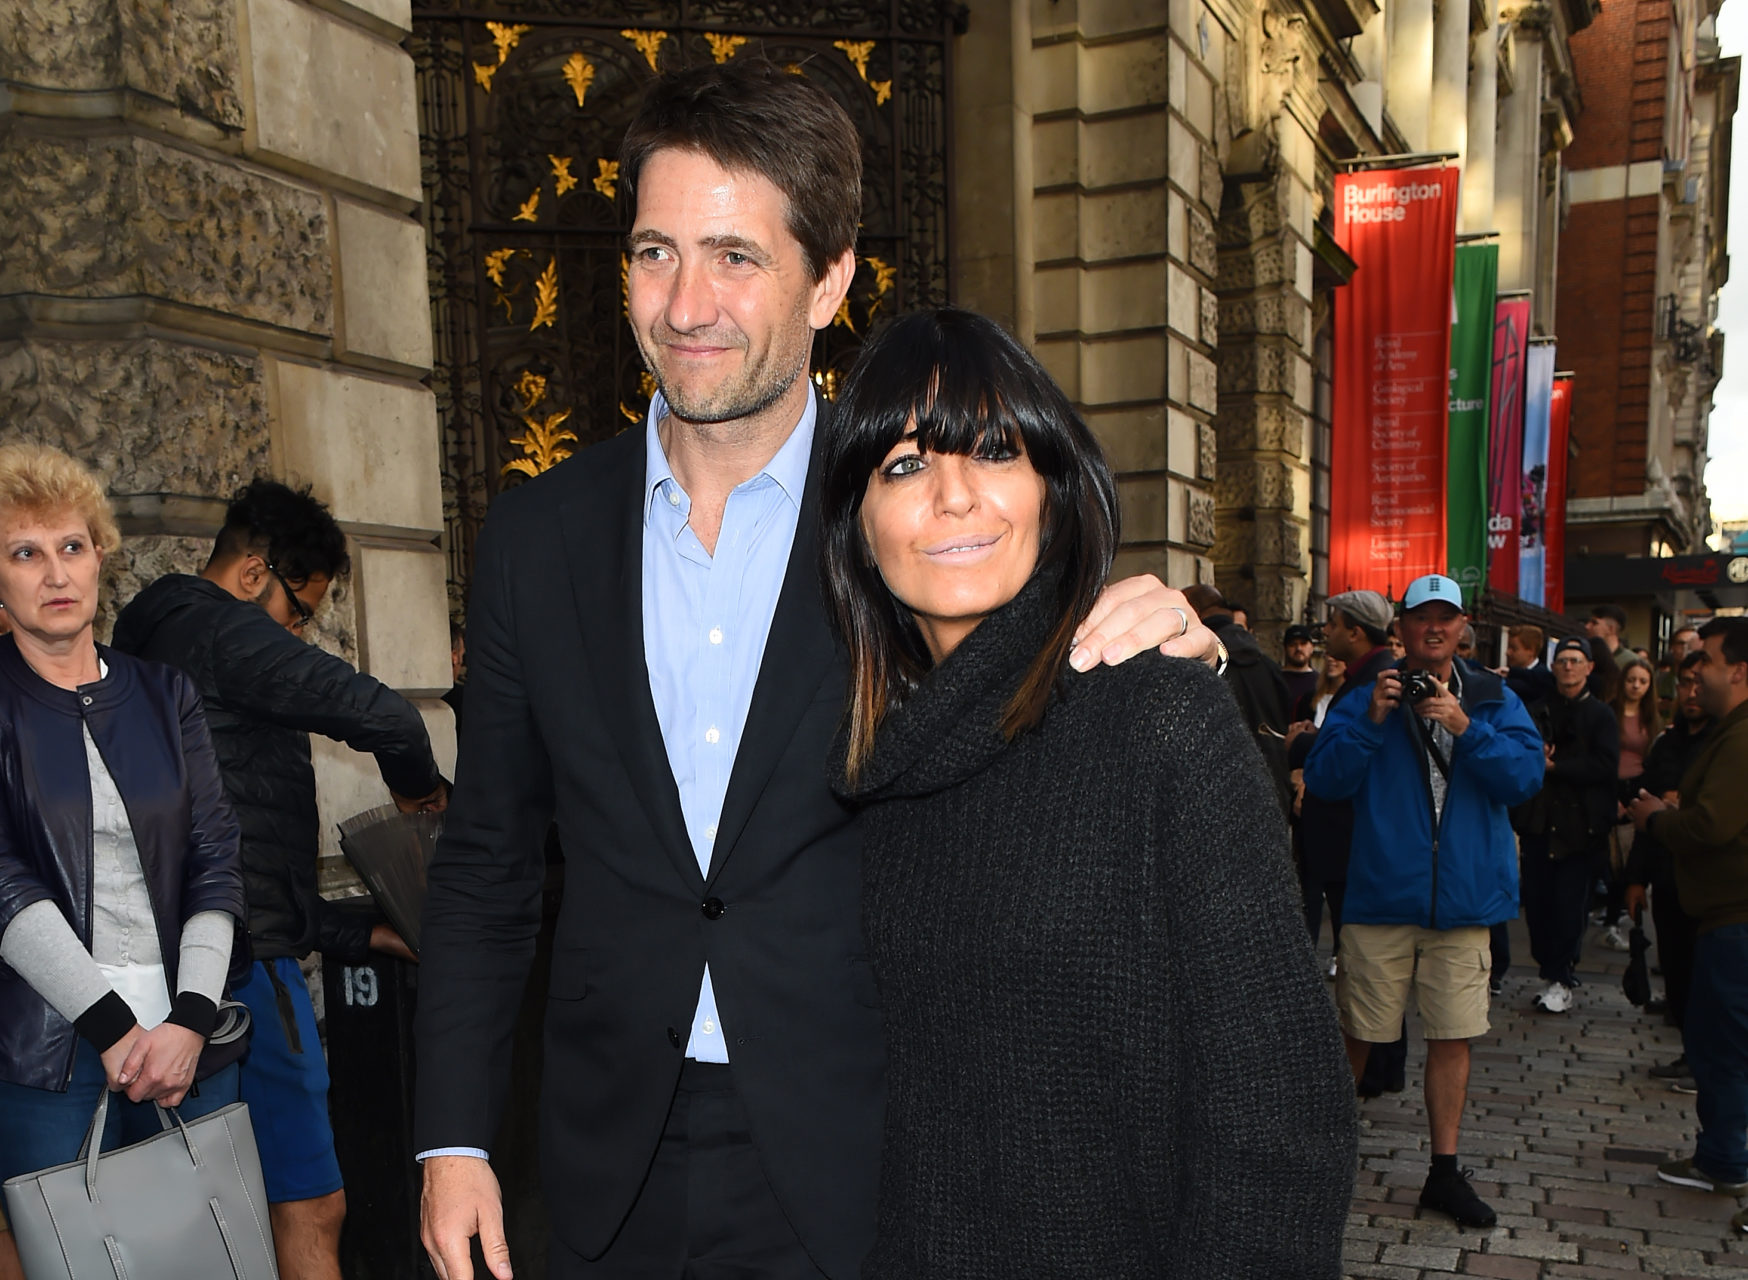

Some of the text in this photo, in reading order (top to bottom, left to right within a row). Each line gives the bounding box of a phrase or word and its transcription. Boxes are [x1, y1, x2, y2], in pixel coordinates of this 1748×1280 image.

[1344, 182, 1441, 206] Burlington
[1344, 204, 1406, 224] House
[1488, 513, 1512, 531] da
[1370, 549, 1403, 562] Society
[344, 966, 378, 1007] 19
